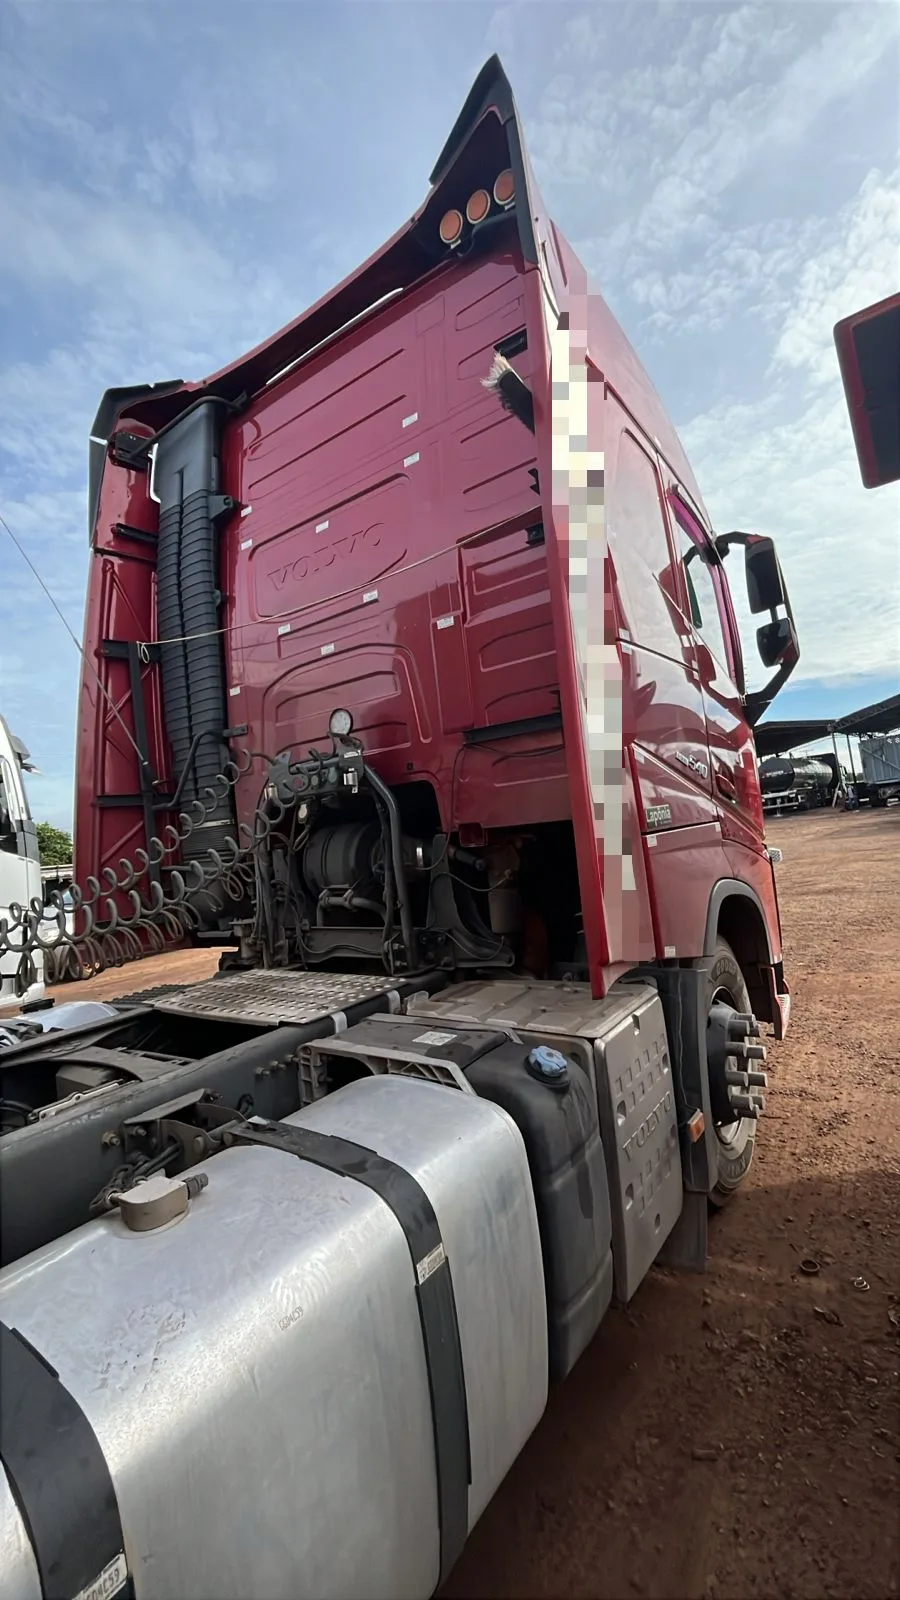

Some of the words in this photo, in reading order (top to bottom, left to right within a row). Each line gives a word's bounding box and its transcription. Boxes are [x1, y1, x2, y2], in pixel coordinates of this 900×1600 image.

[266, 522, 386, 592] VOLVO
[688, 755, 708, 778] 540
[622, 1091, 671, 1162] VOLVO
